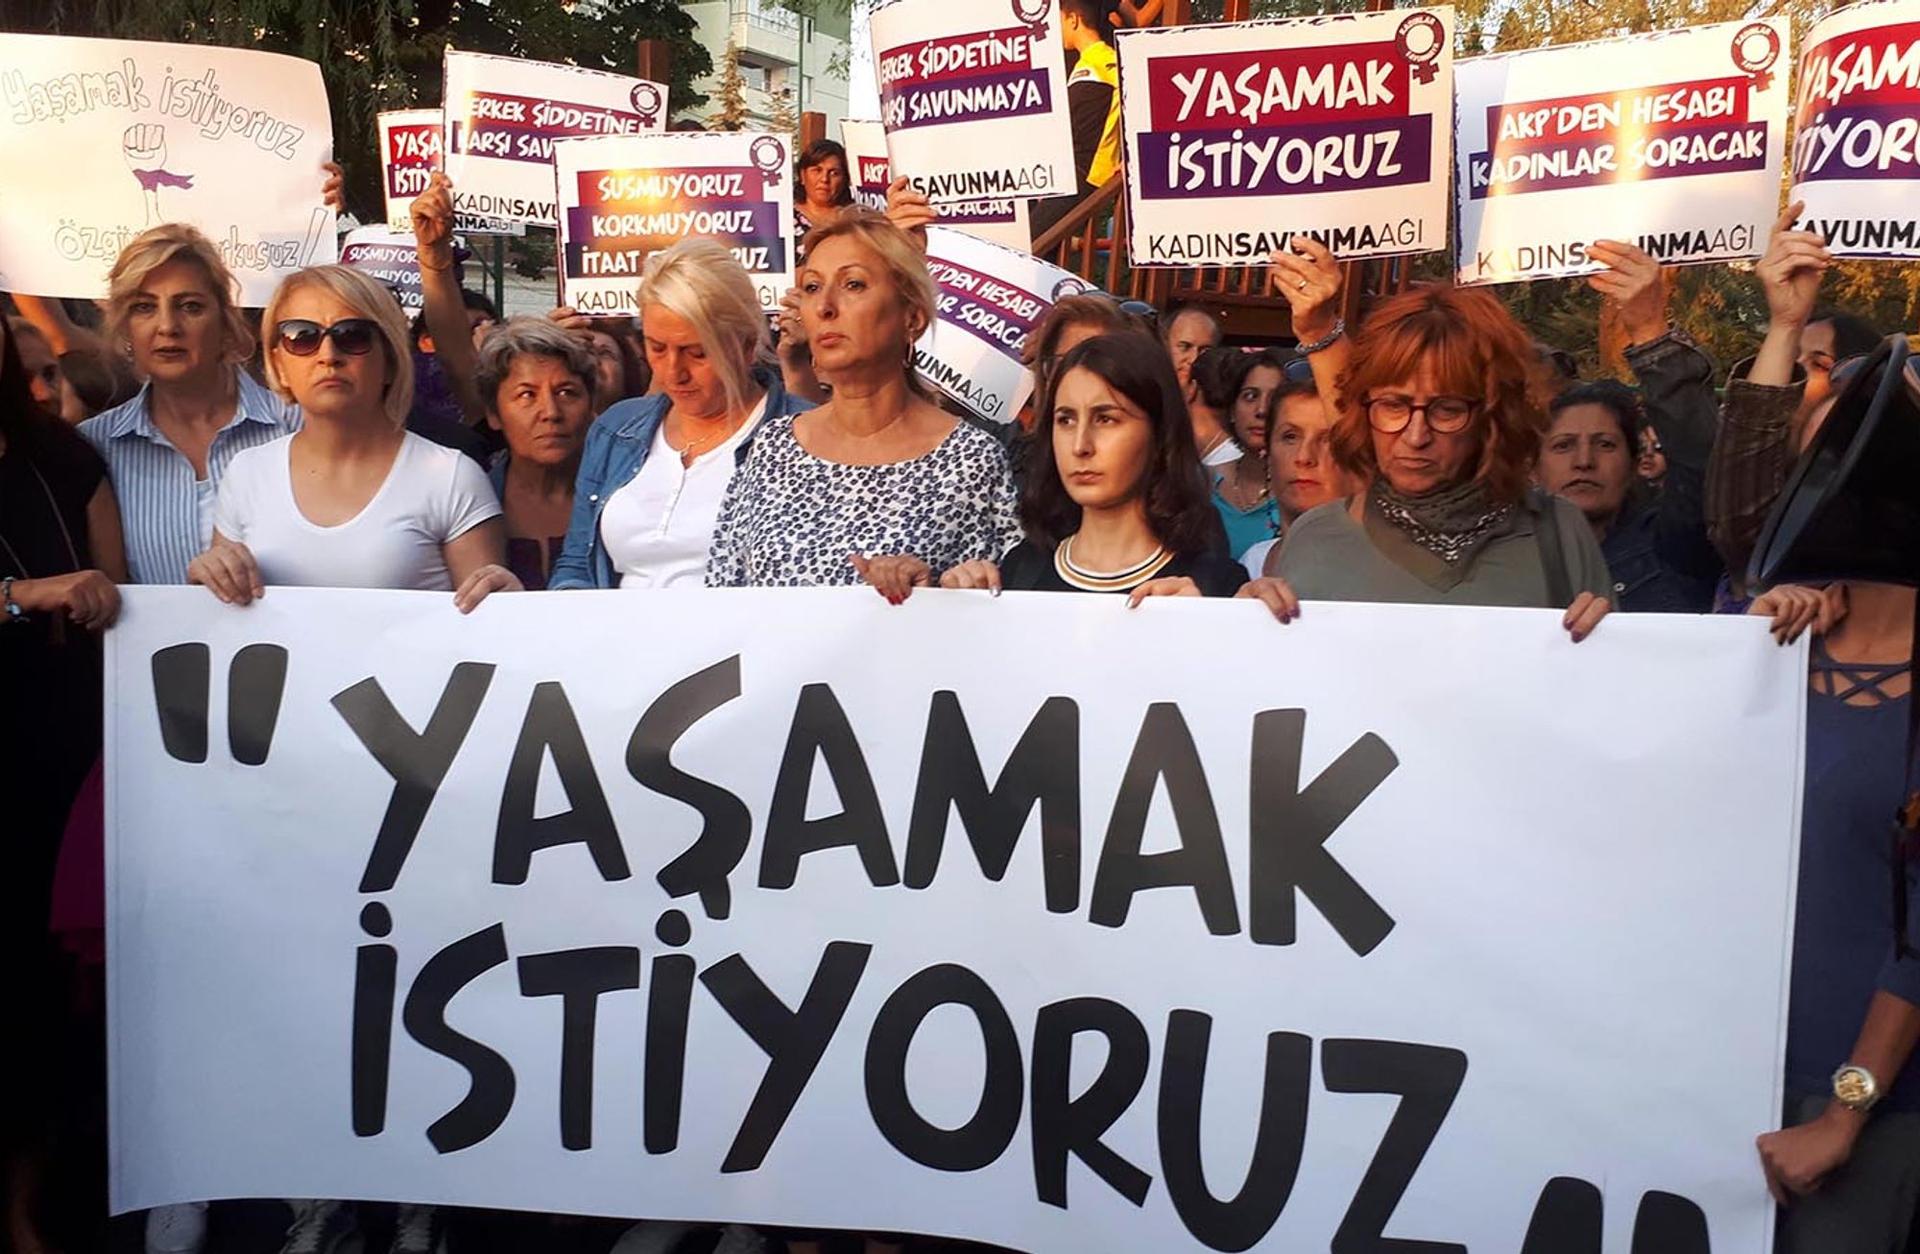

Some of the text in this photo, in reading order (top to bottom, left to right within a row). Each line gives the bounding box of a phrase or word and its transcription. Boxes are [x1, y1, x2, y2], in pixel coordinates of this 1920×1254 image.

[918, 32, 1028, 79] ŞİDDETİNE
[1803, 39, 1920, 106] YAŞAM
[909, 79, 1042, 121] SAVUNMAYA
[1171, 60, 1395, 124] YAŞAMAK
[531, 100, 639, 136] ŞİDDETİNE
[1501, 86, 1736, 141] AKP'DEN HESABI
[394, 130, 442, 161] YAŞA
[1168, 128, 1402, 192] İSTİYORUZ
[1471, 130, 1764, 188] KADINLAR SORACAK
[452, 191, 558, 220] KADINSAVU
[597, 173, 745, 201] SUSMUYORUZ
[592, 210, 754, 237] KORKMUYORUZ
[349, 246, 419, 264] SUSMUYOR
[582, 246, 640, 274] İTAAT
[975, 281, 1043, 322] HESABI
[955, 302, 1029, 349] SORACA
